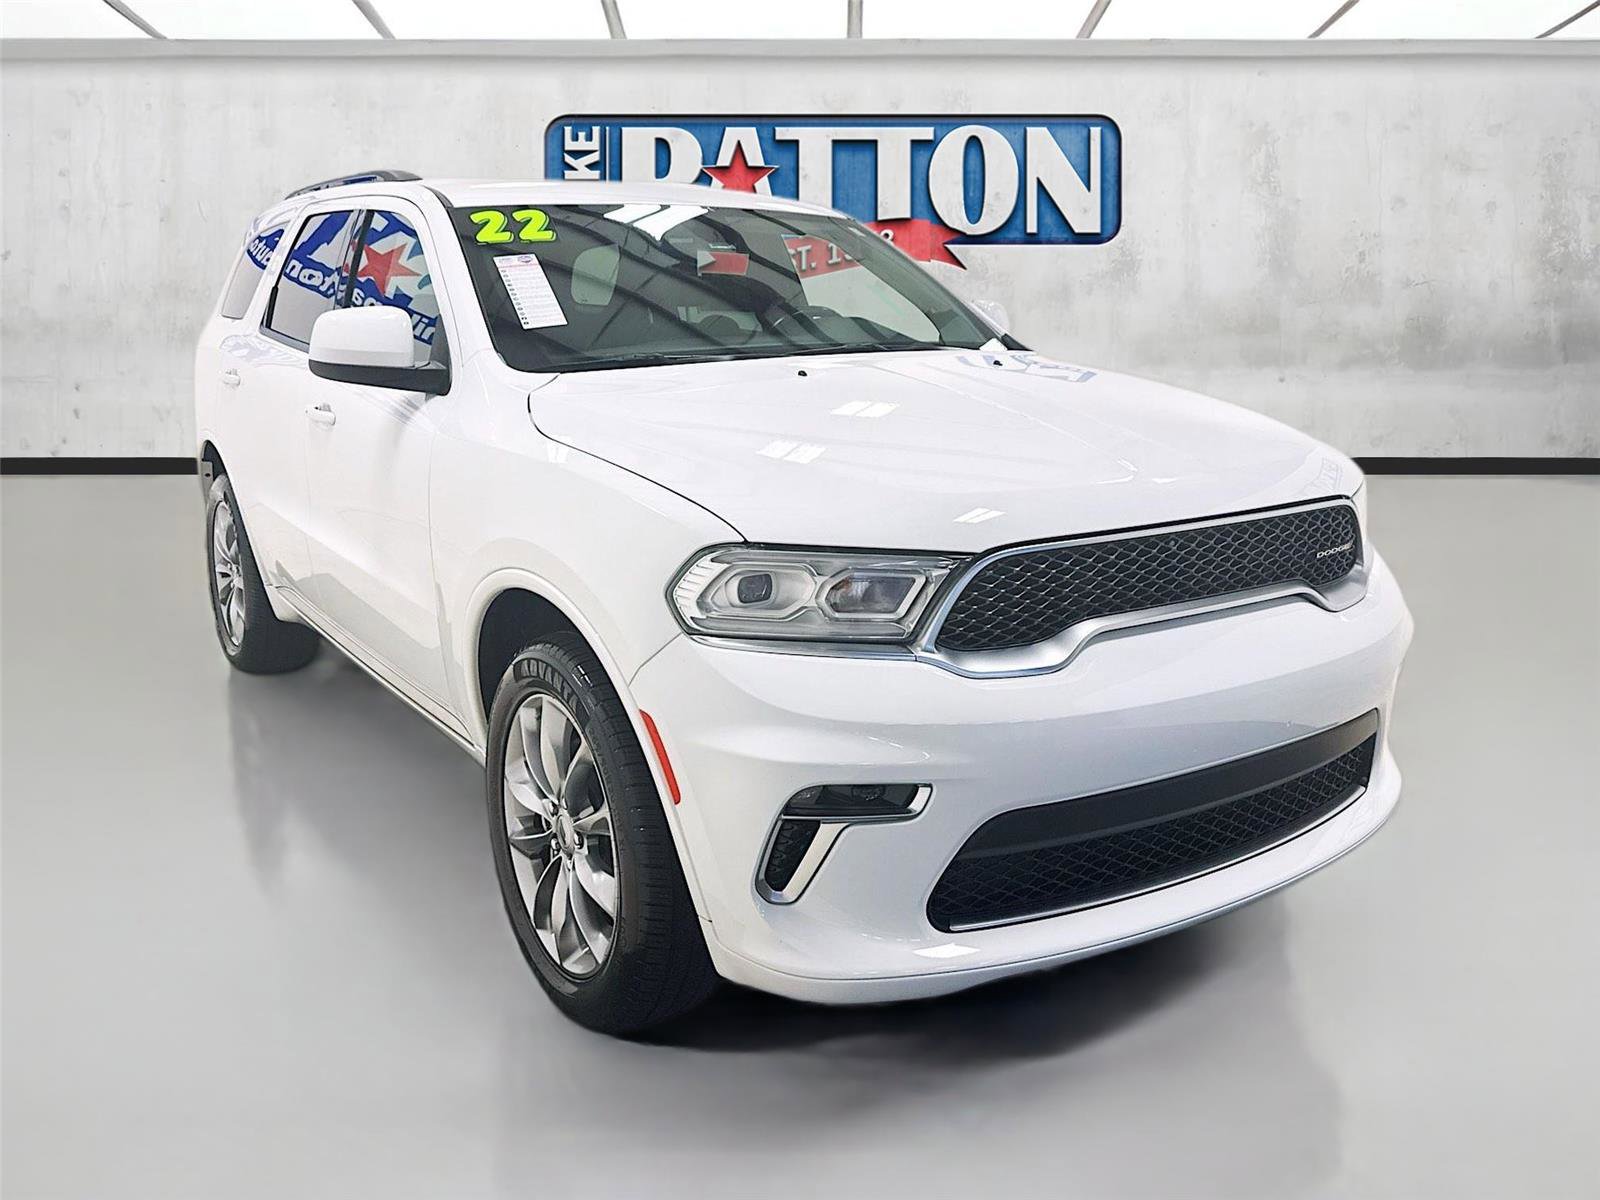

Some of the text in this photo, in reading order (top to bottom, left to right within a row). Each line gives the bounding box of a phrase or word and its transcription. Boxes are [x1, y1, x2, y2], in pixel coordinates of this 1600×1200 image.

[564, 126, 600, 180] KE
[621, 125, 1102, 236] PATTON
[470, 209, 557, 245] 22
